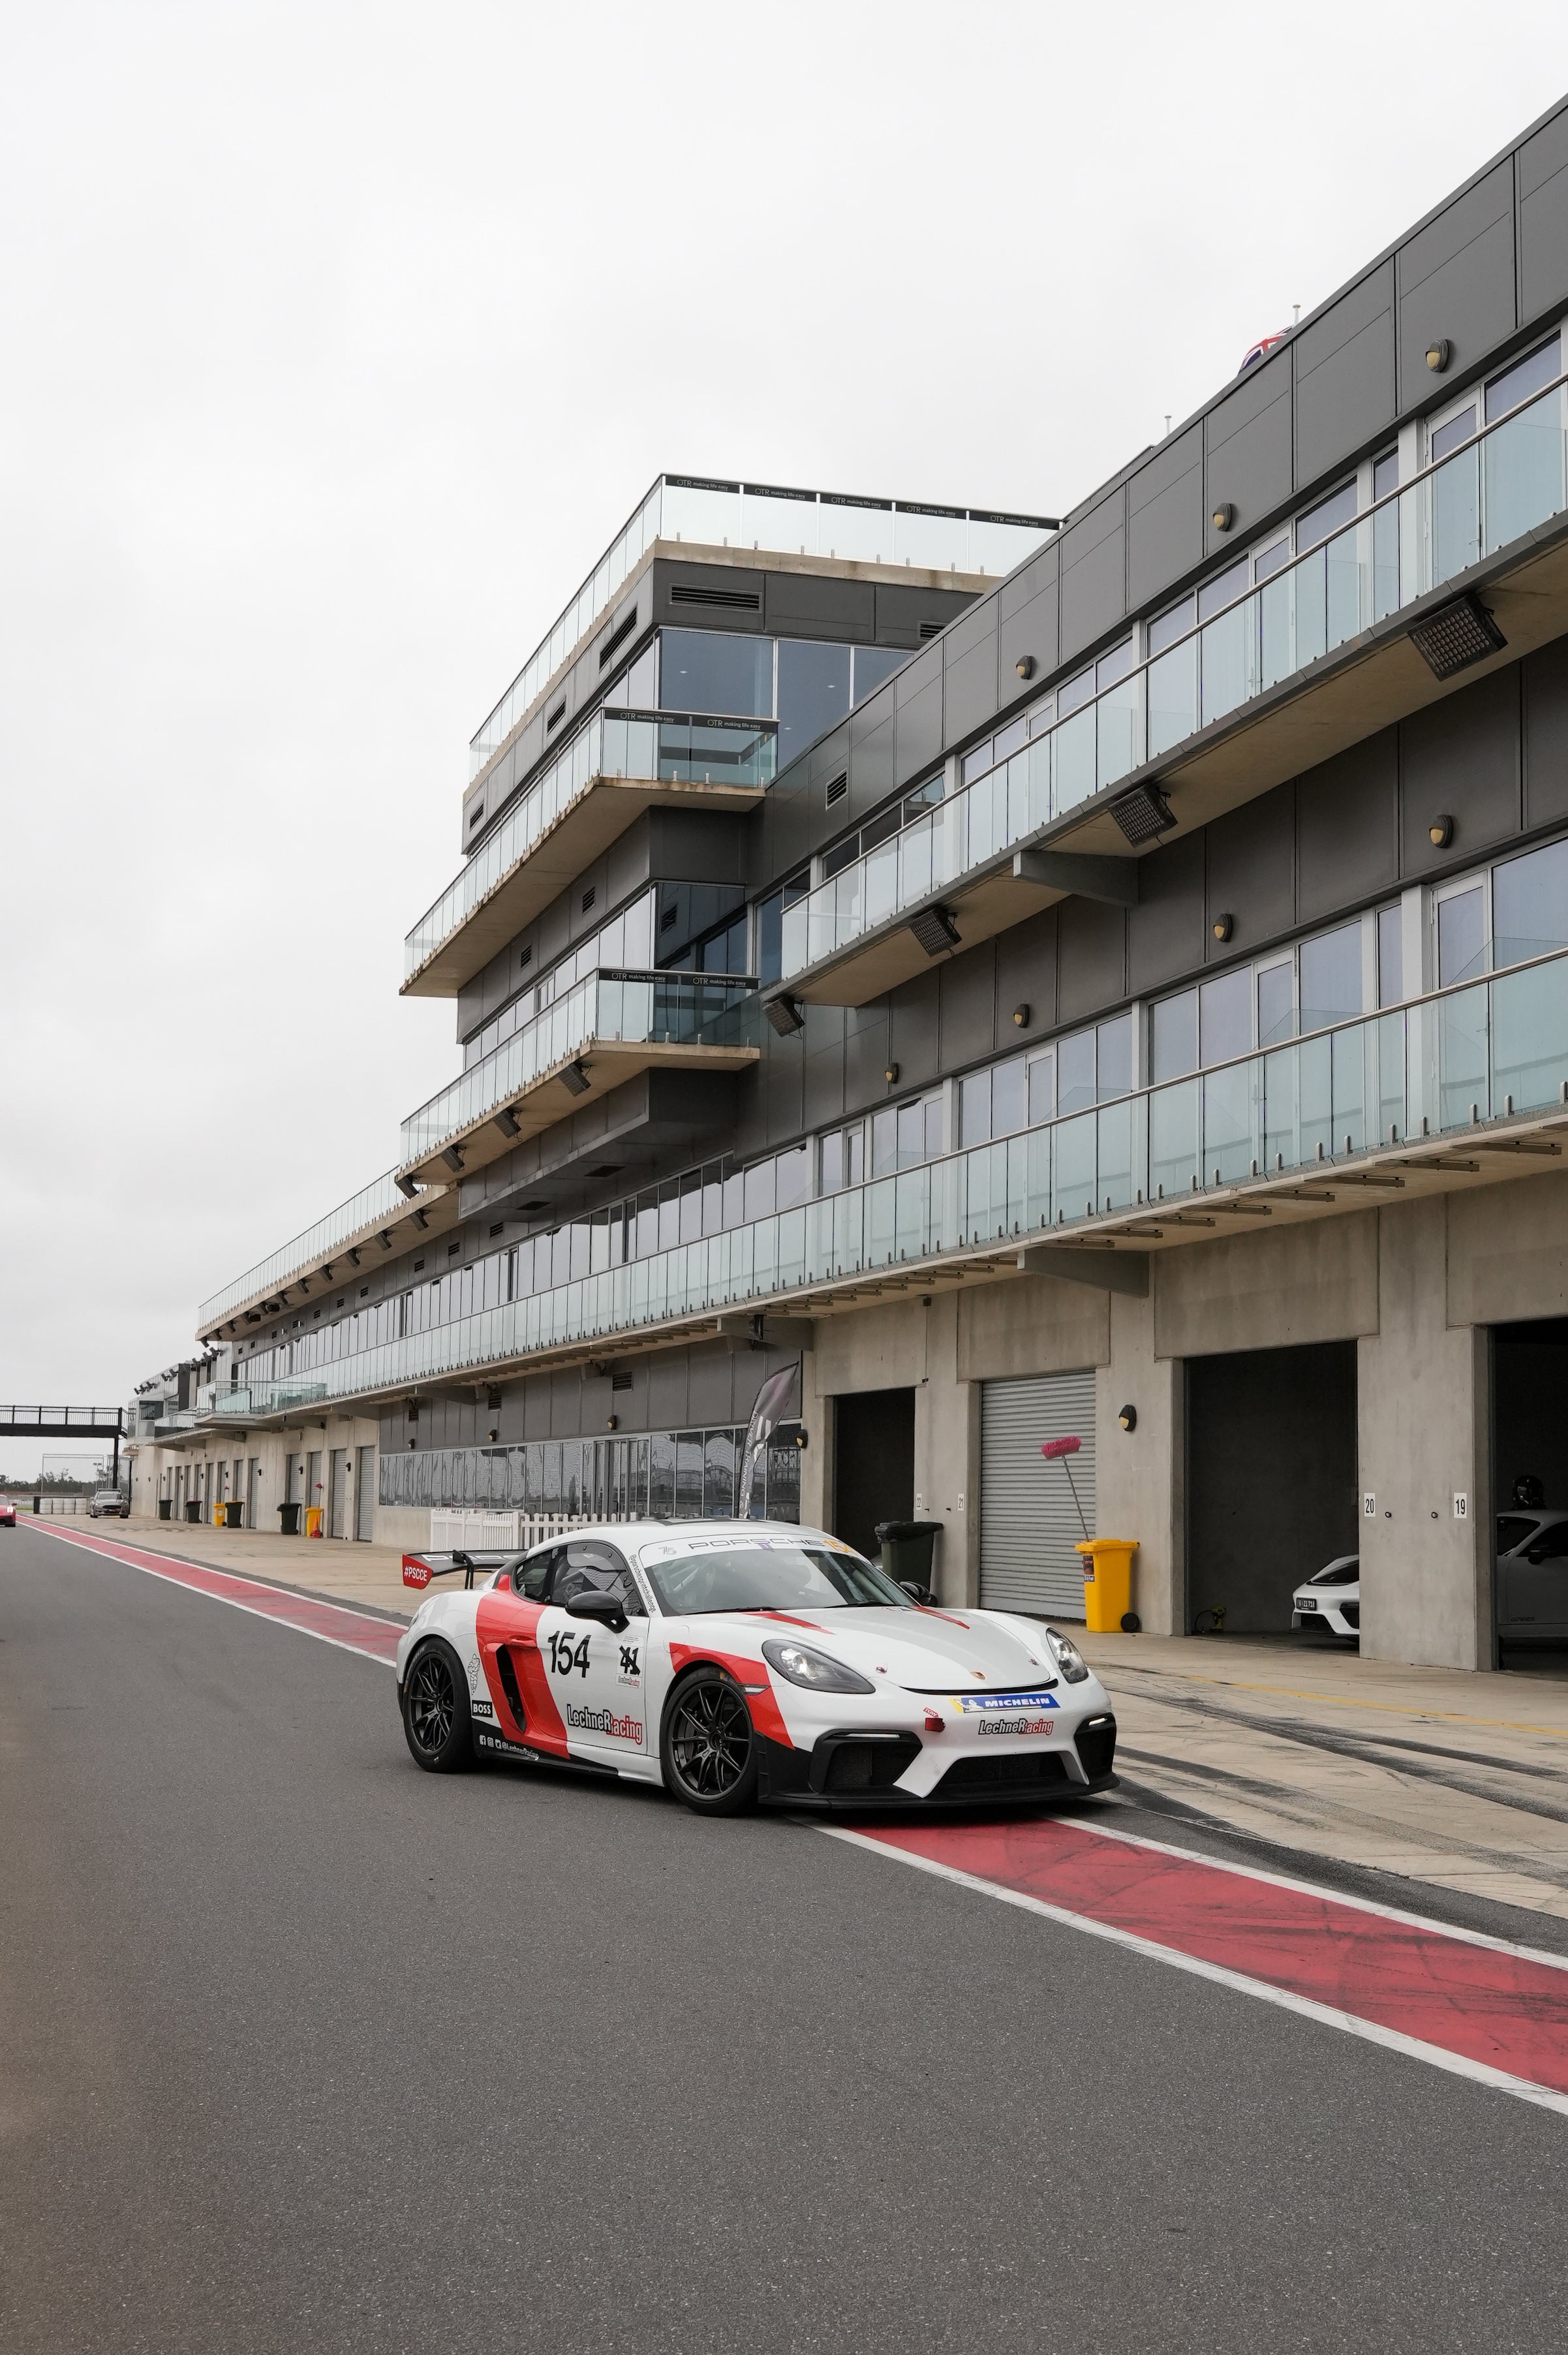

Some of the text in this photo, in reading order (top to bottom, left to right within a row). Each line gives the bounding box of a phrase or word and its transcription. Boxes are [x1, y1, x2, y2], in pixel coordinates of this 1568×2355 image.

[741, 1450, 752, 1497] TRAINING
[917, 1497, 921, 1507] 22
[959, 1497, 963, 1508] 21
[1366, 1499, 1374, 1513] 20
[1456, 1499, 1466, 1515] 19
[688, 1538, 825, 1550] PORSCHE
[404, 1566, 427, 1582] #PSCCE
[628, 1554, 656, 1613] @porschesprintchallenge
[547, 1630, 592, 1678] 154
[472, 1703, 491, 1715] BOSS
[985, 1698, 1050, 1708] MICHELIN
[924, 1708, 937, 1717] TOW
